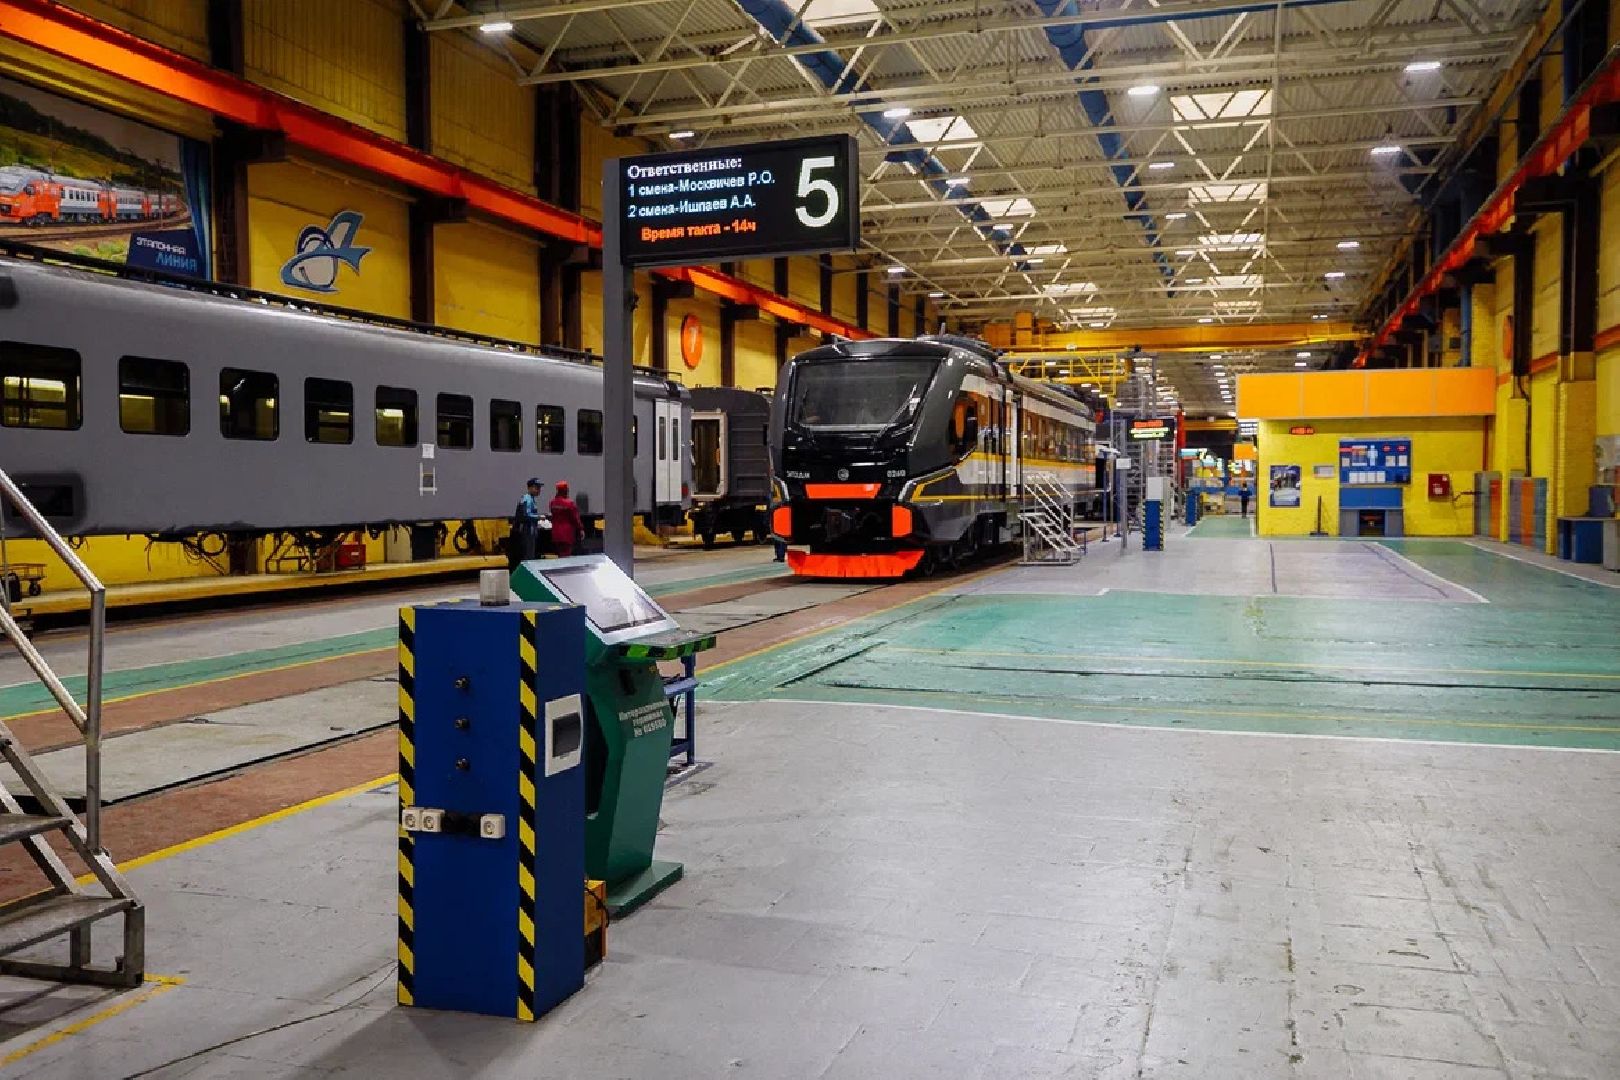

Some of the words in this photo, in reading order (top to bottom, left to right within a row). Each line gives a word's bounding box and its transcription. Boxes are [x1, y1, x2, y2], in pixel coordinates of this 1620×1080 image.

[627, 158, 742, 179] Ответственные:
[628, 184, 635, 197] 1
[748, 170, 776, 187] Р.О.
[796, 156, 839, 227] 5
[628, 204, 637, 218] 2
[730, 194, 757, 209] А.А.
[641, 226, 685, 243] Время
[687, 223, 721, 237] такта
[156, 252, 198, 272] ЛИНИЯ
